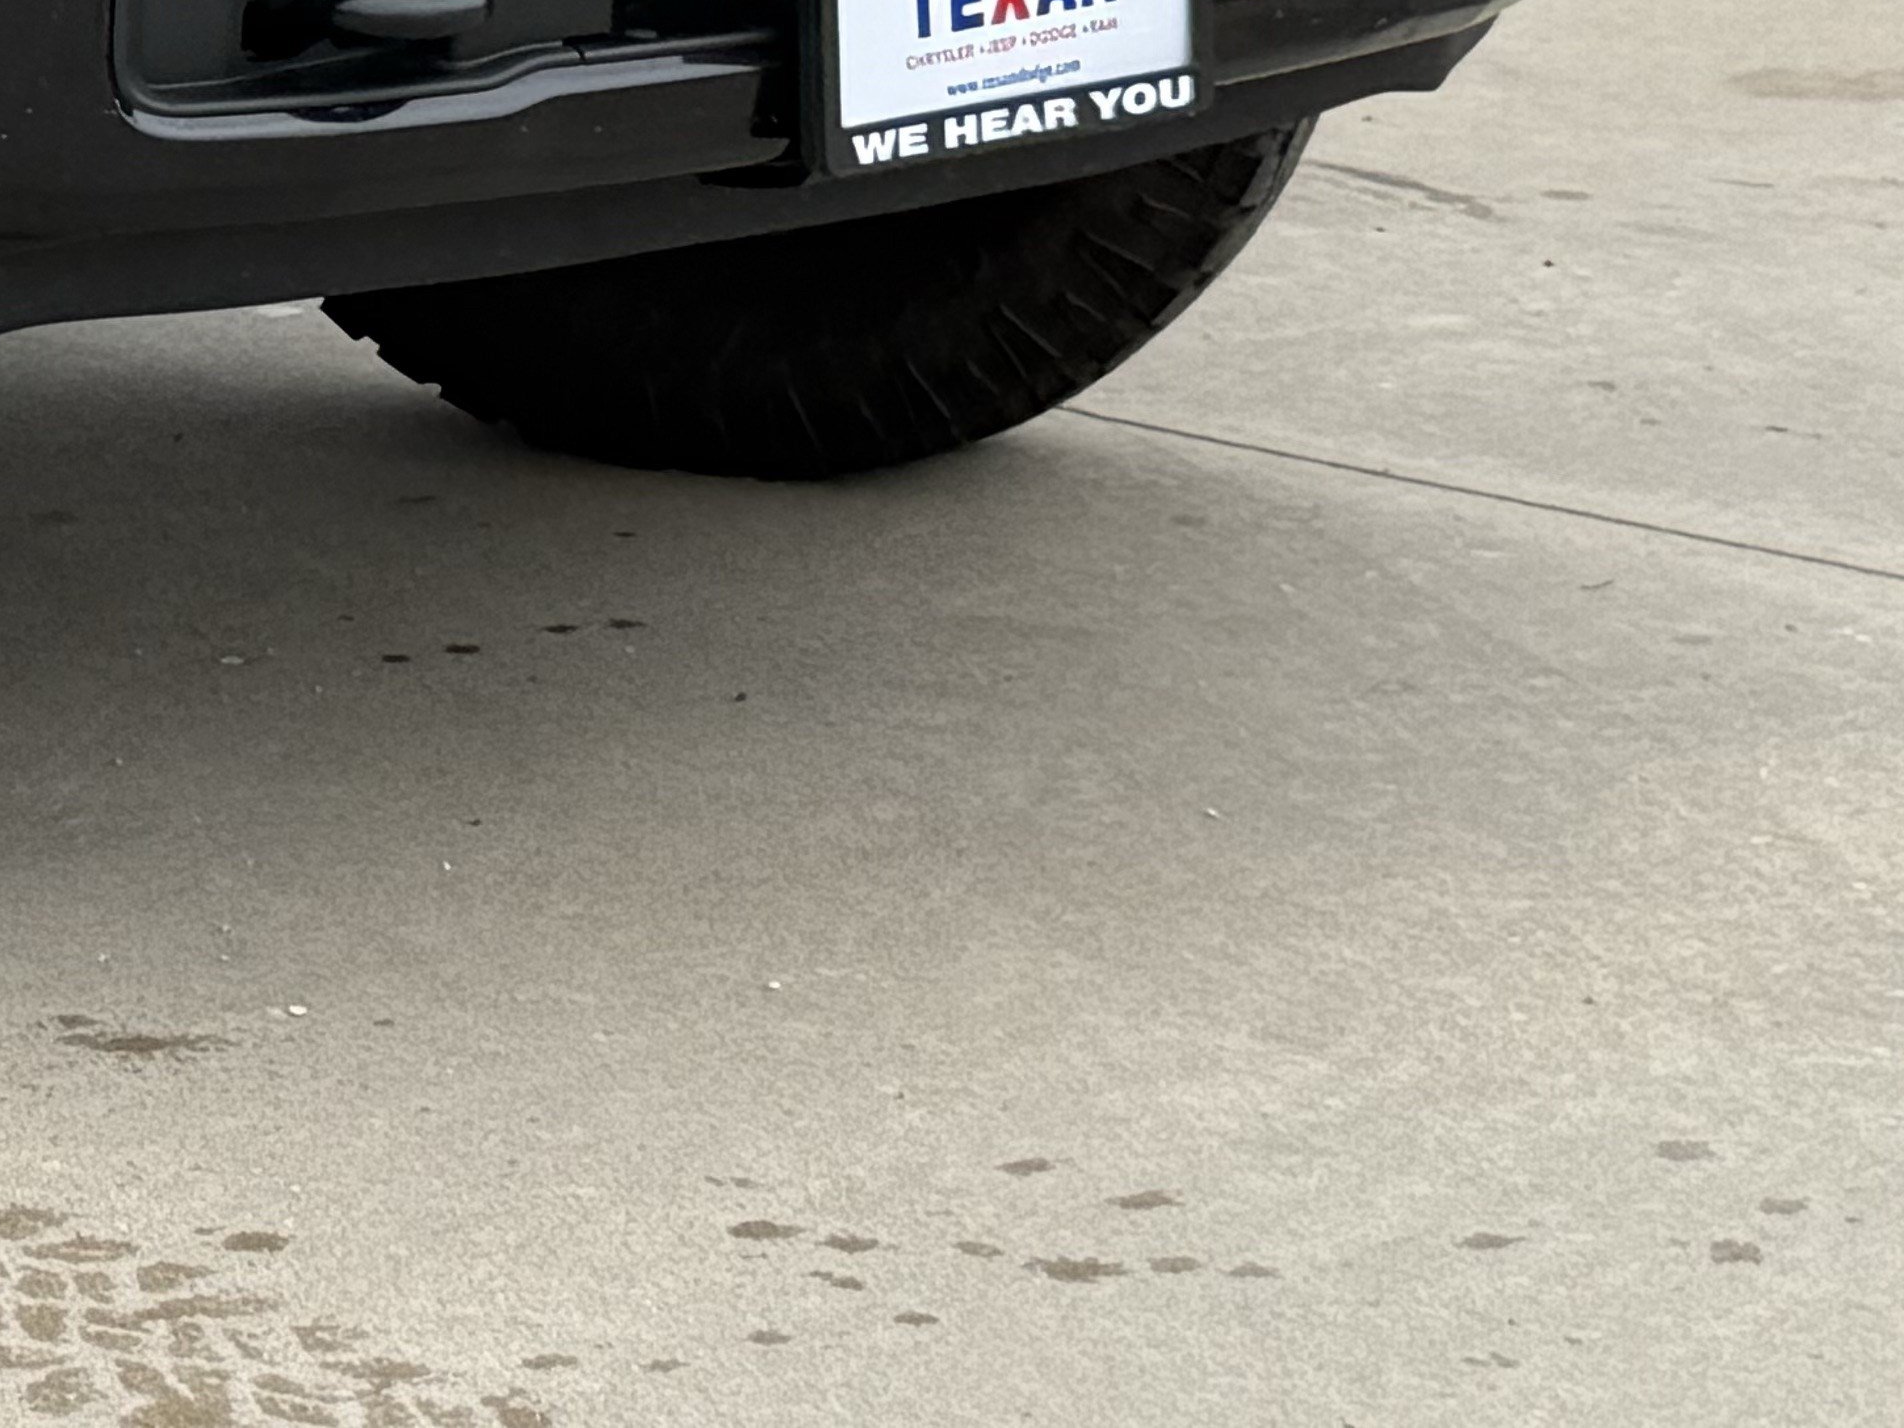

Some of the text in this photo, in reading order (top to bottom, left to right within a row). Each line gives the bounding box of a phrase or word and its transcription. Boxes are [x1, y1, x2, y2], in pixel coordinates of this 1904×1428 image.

[852, 75, 1195, 166] WE HEAR YOU
